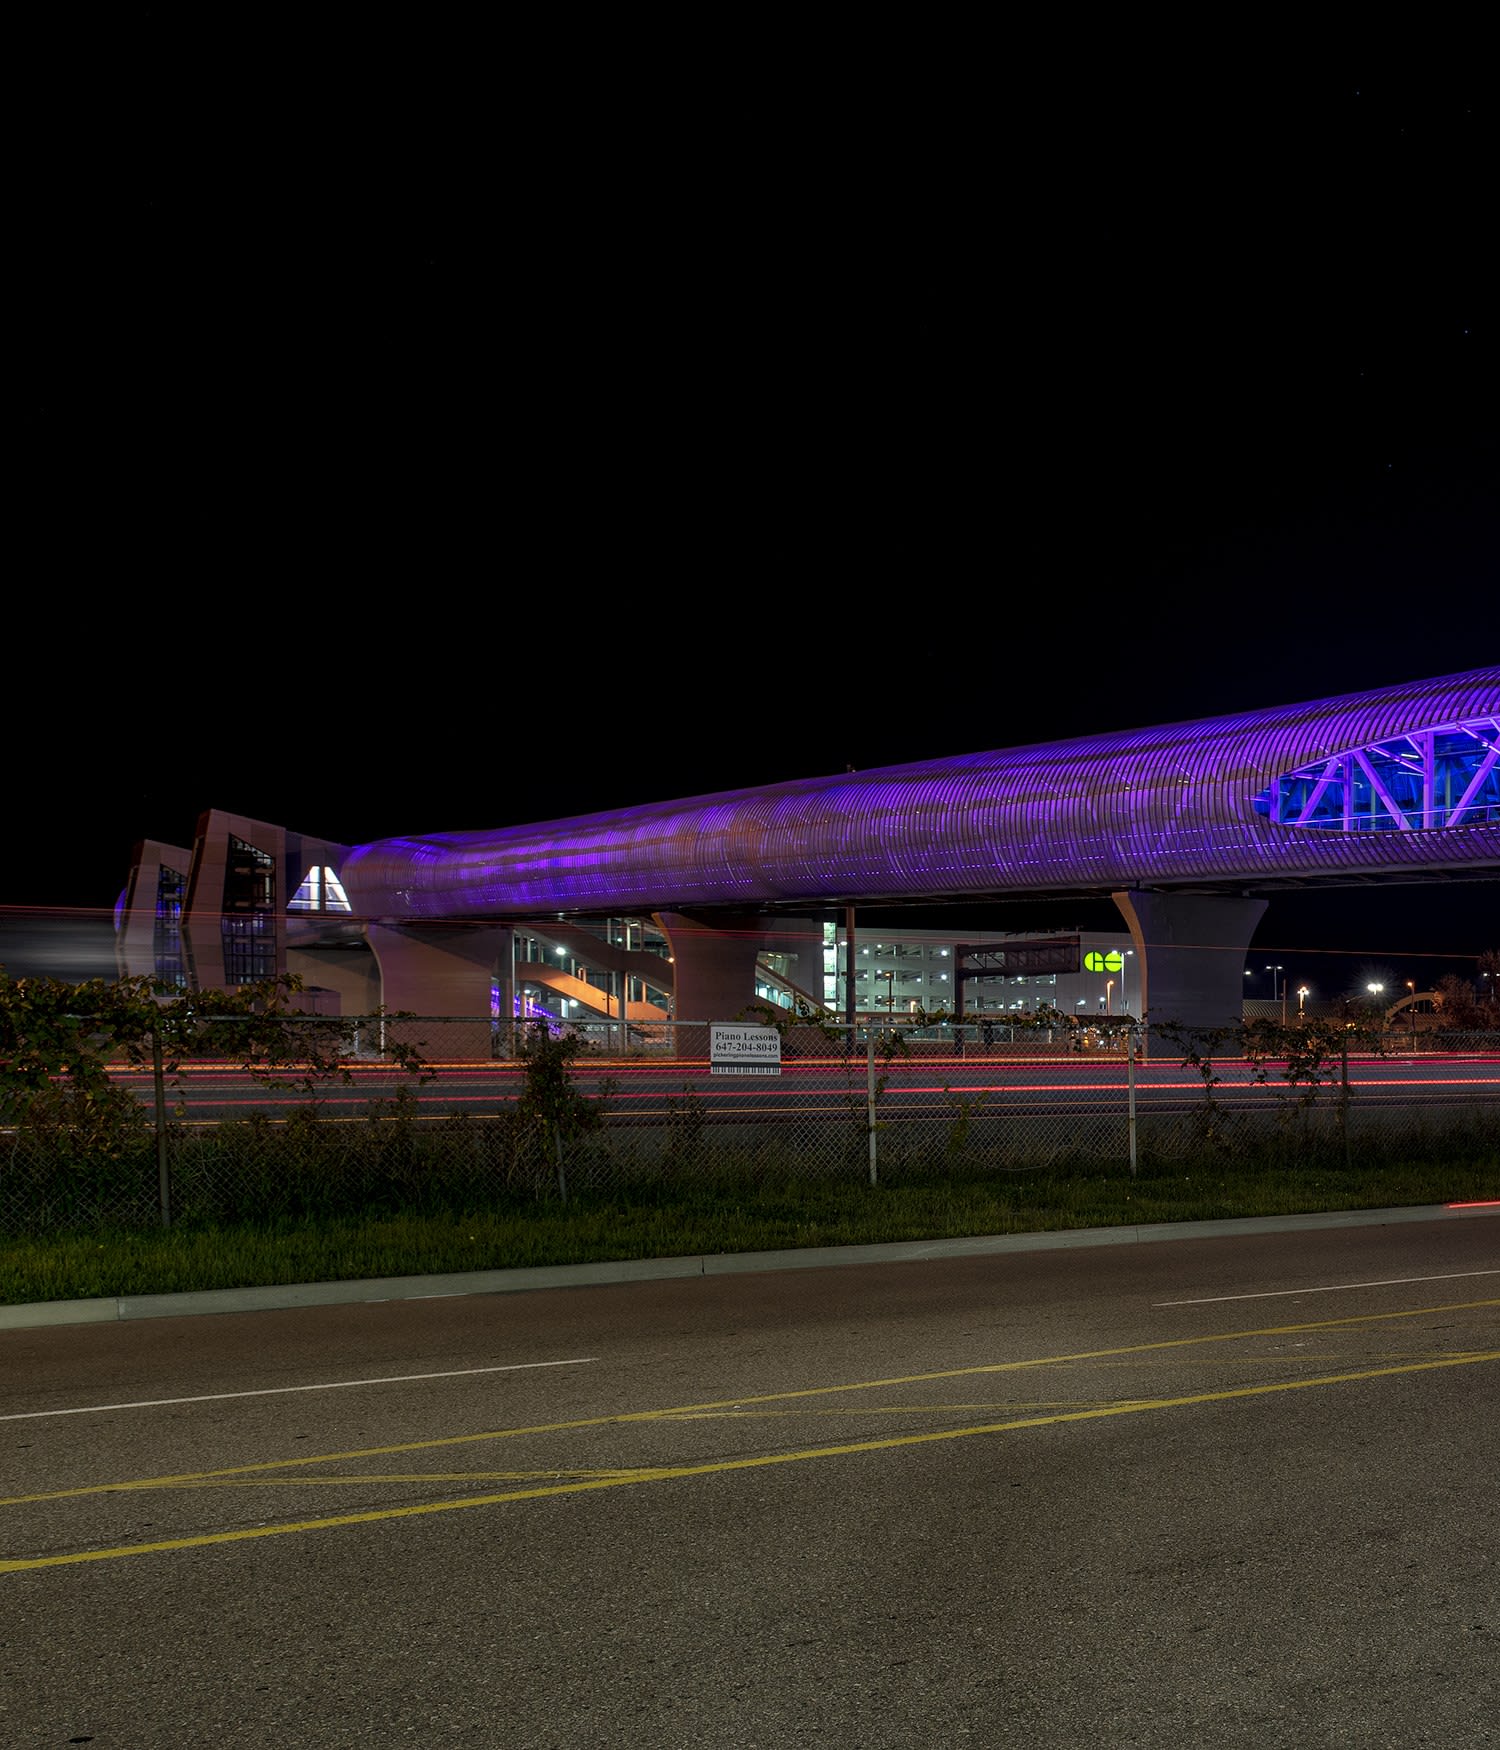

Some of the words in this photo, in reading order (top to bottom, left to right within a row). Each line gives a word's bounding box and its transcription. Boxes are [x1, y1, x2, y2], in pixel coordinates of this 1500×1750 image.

[1084, 951, 1122, 972] GO
[715, 1031, 741, 1040] Piano
[744, 1032, 778, 1041] Lessons
[716, 1043, 778, 1052] 647-204-8049
